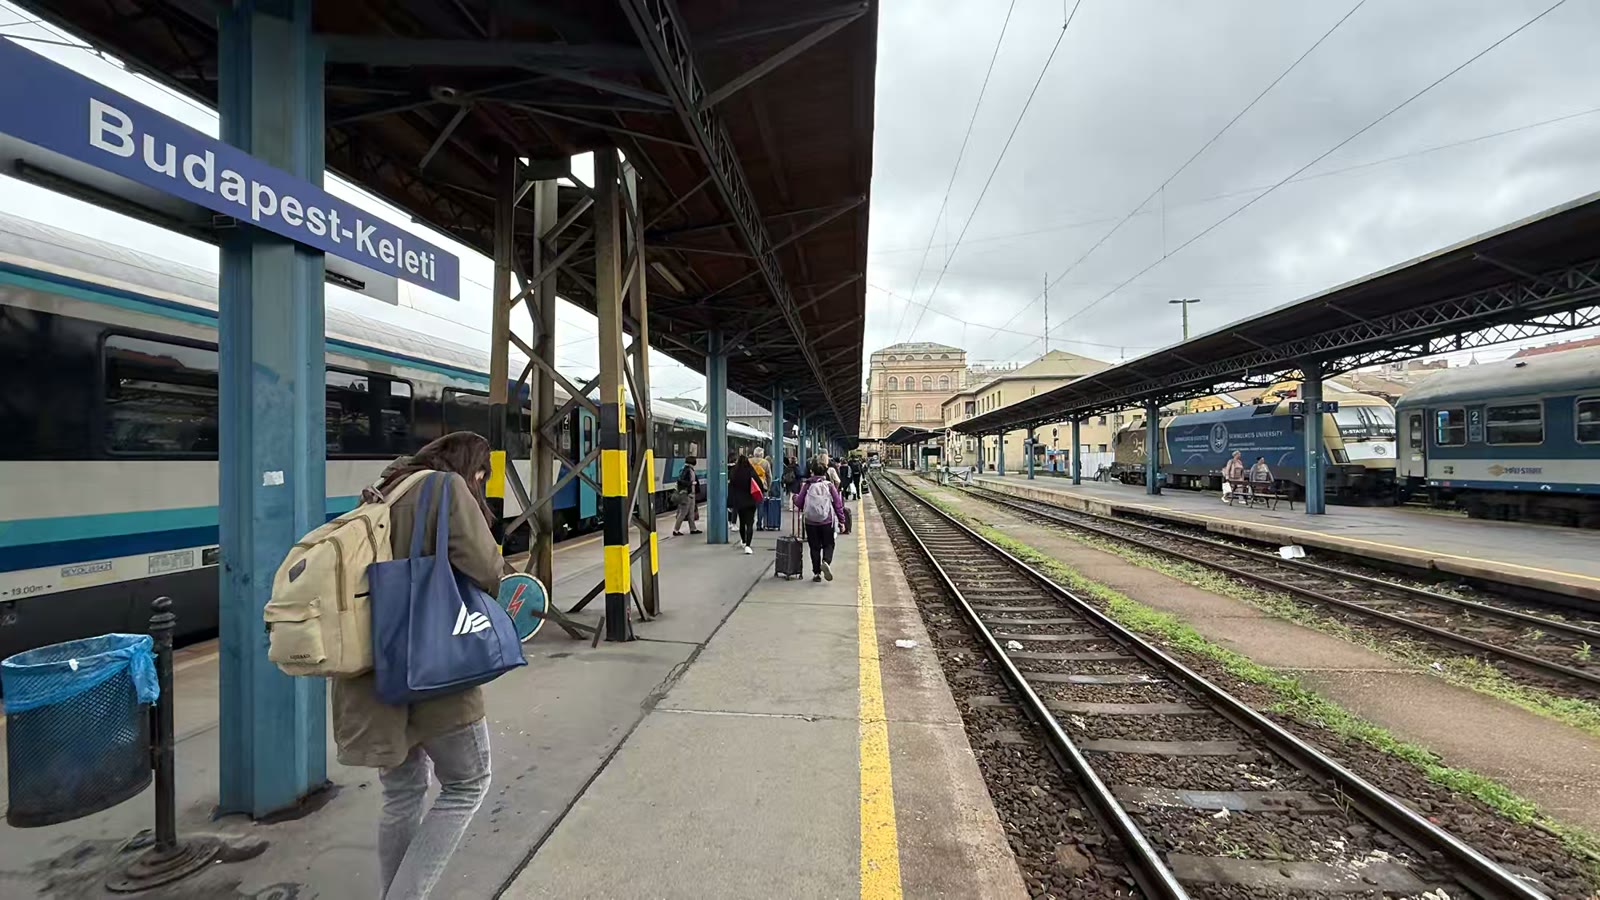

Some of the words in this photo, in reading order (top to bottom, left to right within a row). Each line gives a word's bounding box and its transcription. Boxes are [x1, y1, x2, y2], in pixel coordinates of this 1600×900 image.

[88, 97, 437, 283] Budapest-Keleti
[564, 415, 569, 425] 2
[1471, 411, 1479, 421] 2
[1256, 430, 1283, 439] UNIVERSITY
